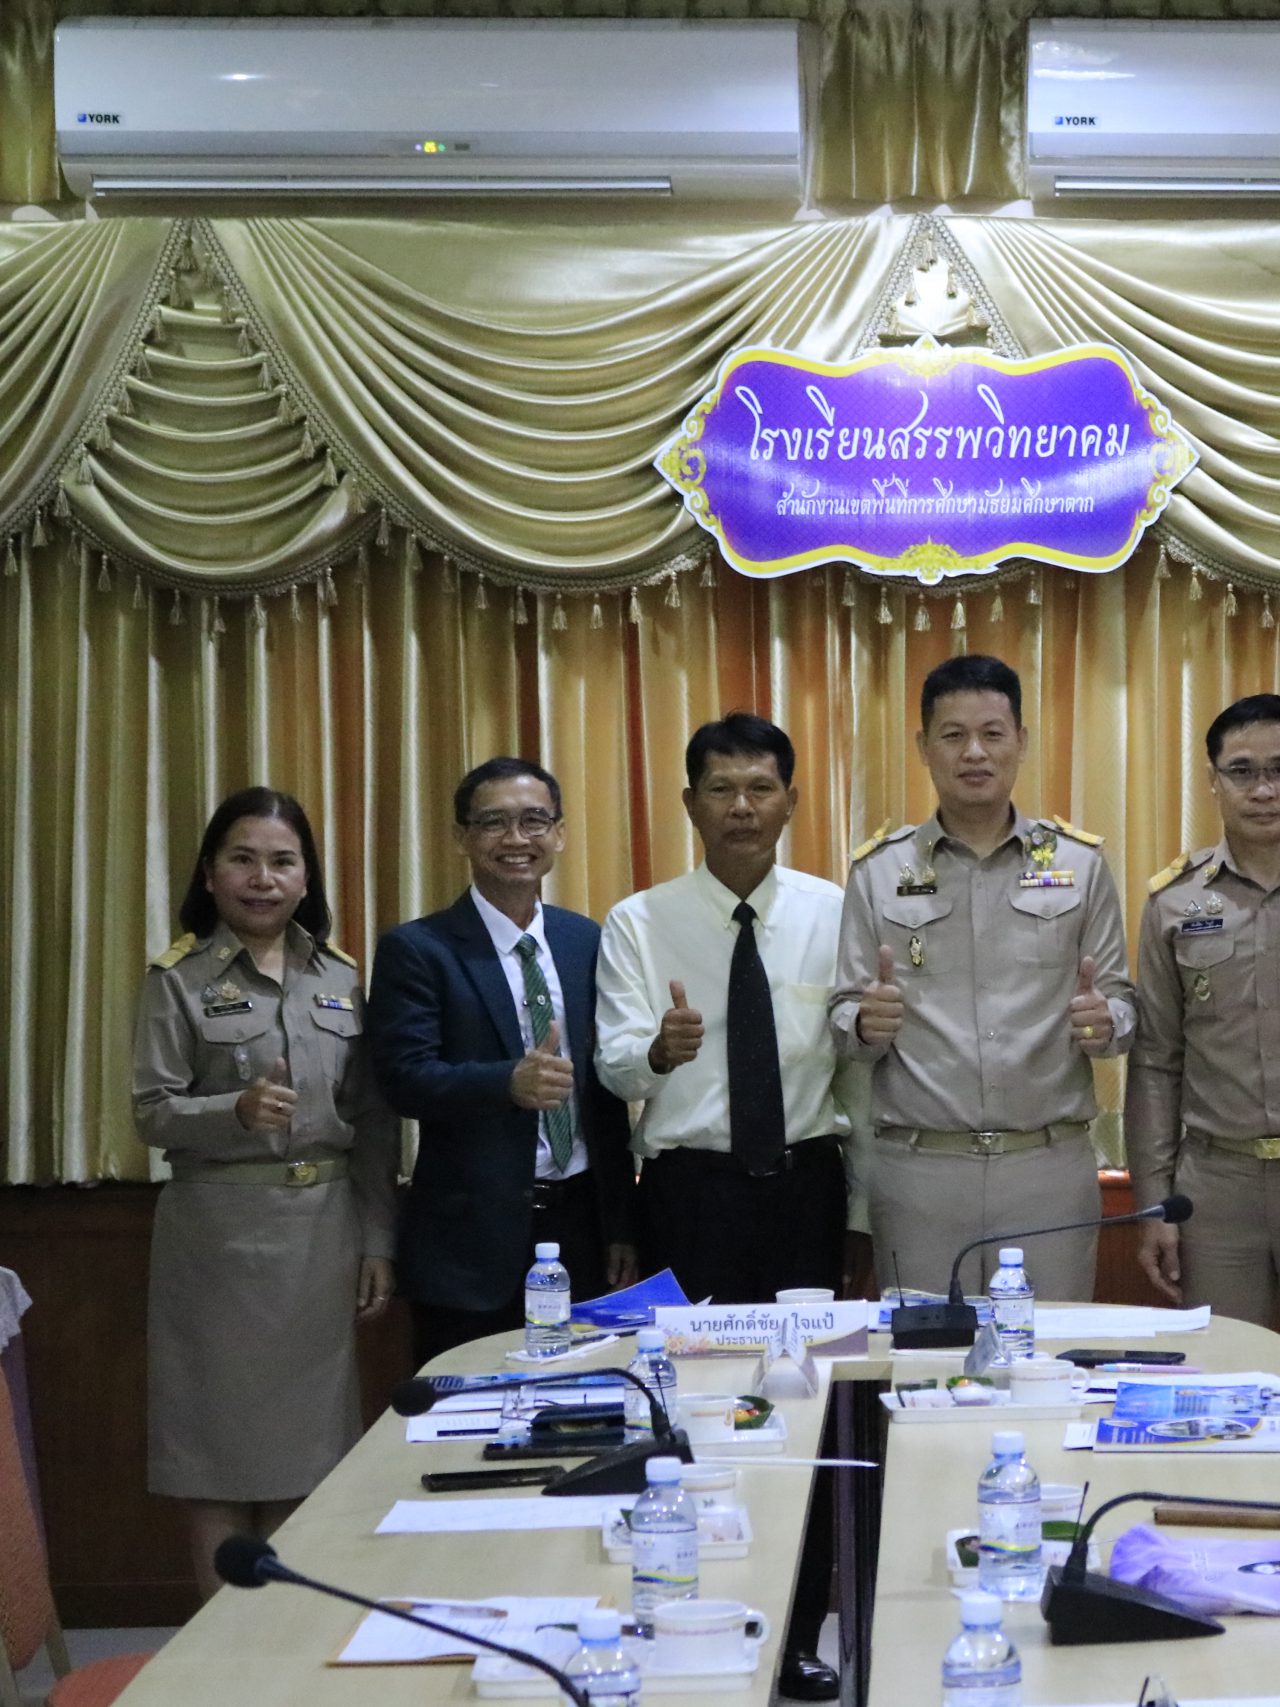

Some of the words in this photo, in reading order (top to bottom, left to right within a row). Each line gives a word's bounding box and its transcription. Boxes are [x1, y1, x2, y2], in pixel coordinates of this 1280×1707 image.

[88, 113, 120, 124] YORK
[1065, 116, 1096, 126] YORK
[735, 384, 1130, 461] โรงเรียนสรรพวิทยาคม
[776, 472, 1095, 516] สำนักงานเขตพื้นที่การศึกษามัธยมศึกษาตาก
[689, 1309, 779, 1332] นายศักดิ์ชัย
